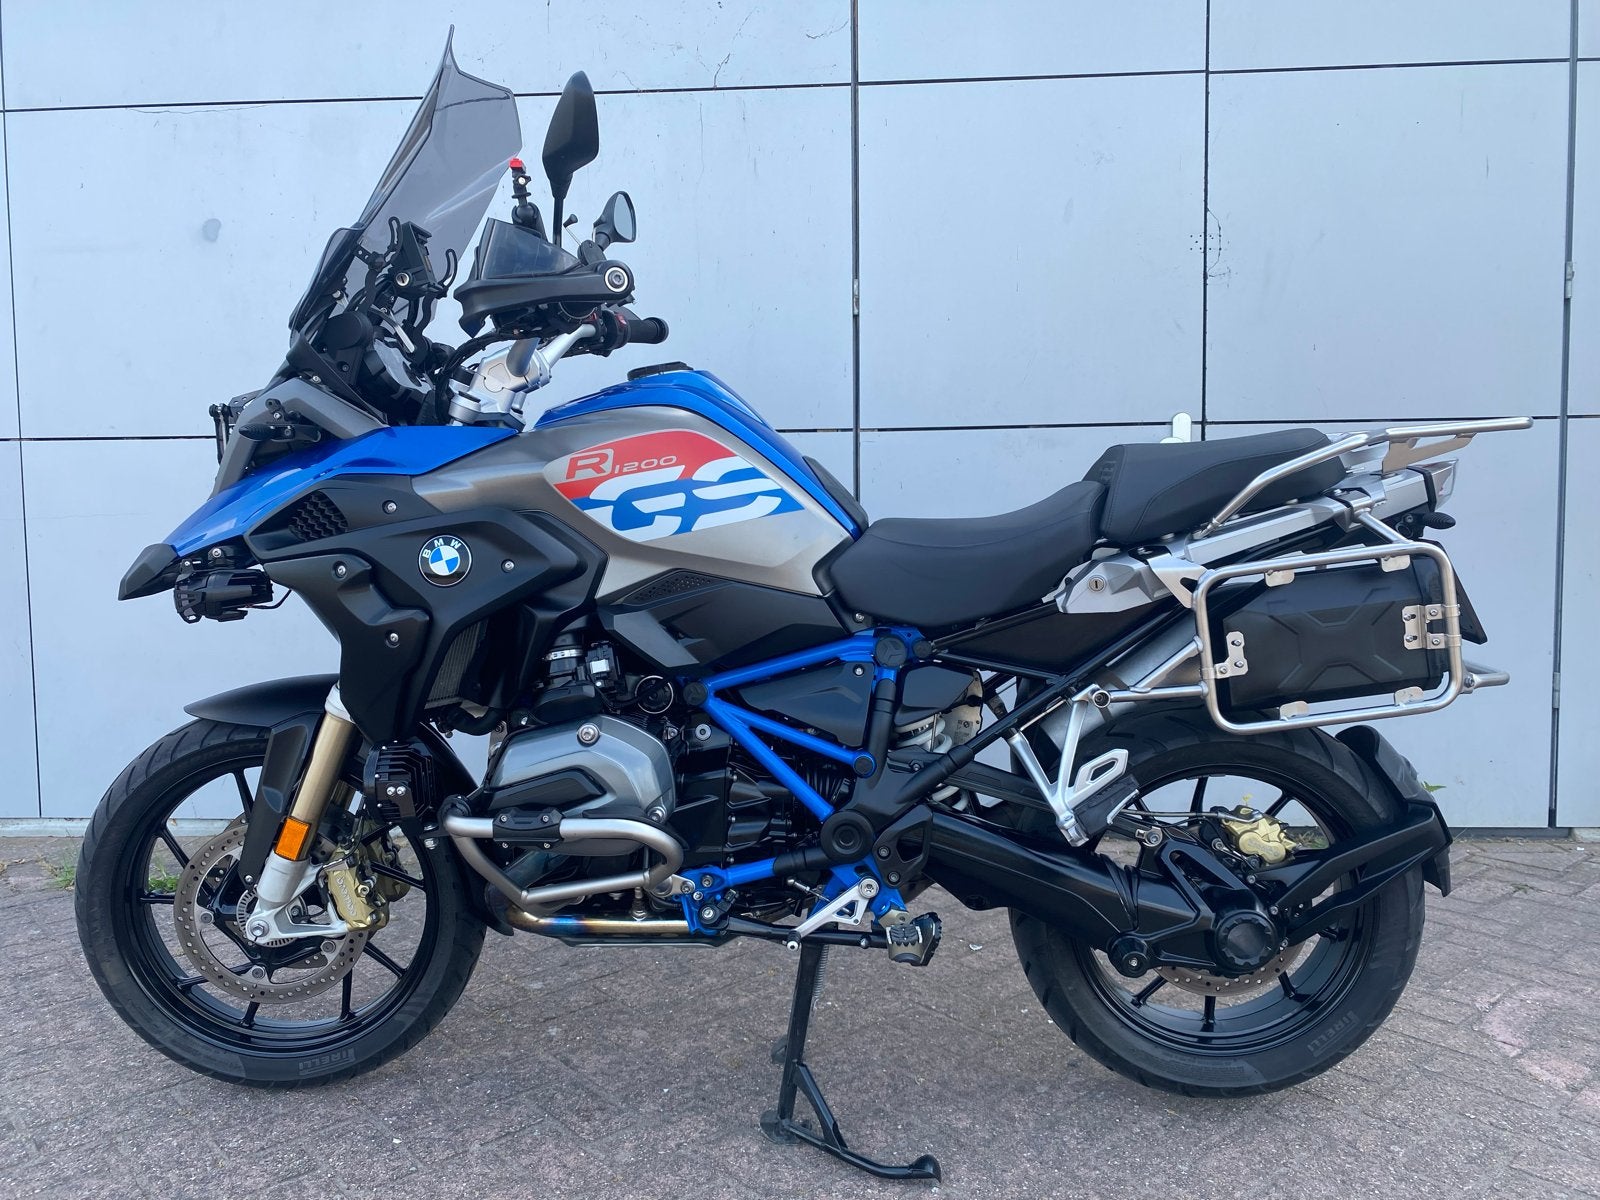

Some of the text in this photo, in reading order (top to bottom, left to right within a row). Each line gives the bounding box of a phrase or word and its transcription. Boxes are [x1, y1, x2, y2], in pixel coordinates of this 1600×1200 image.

[584, 456, 782, 543] GS
[422, 538, 461, 559] BMW
[1307, 1010, 1361, 1058] PIRELLI
[299, 1047, 356, 1076] PIRELLI
